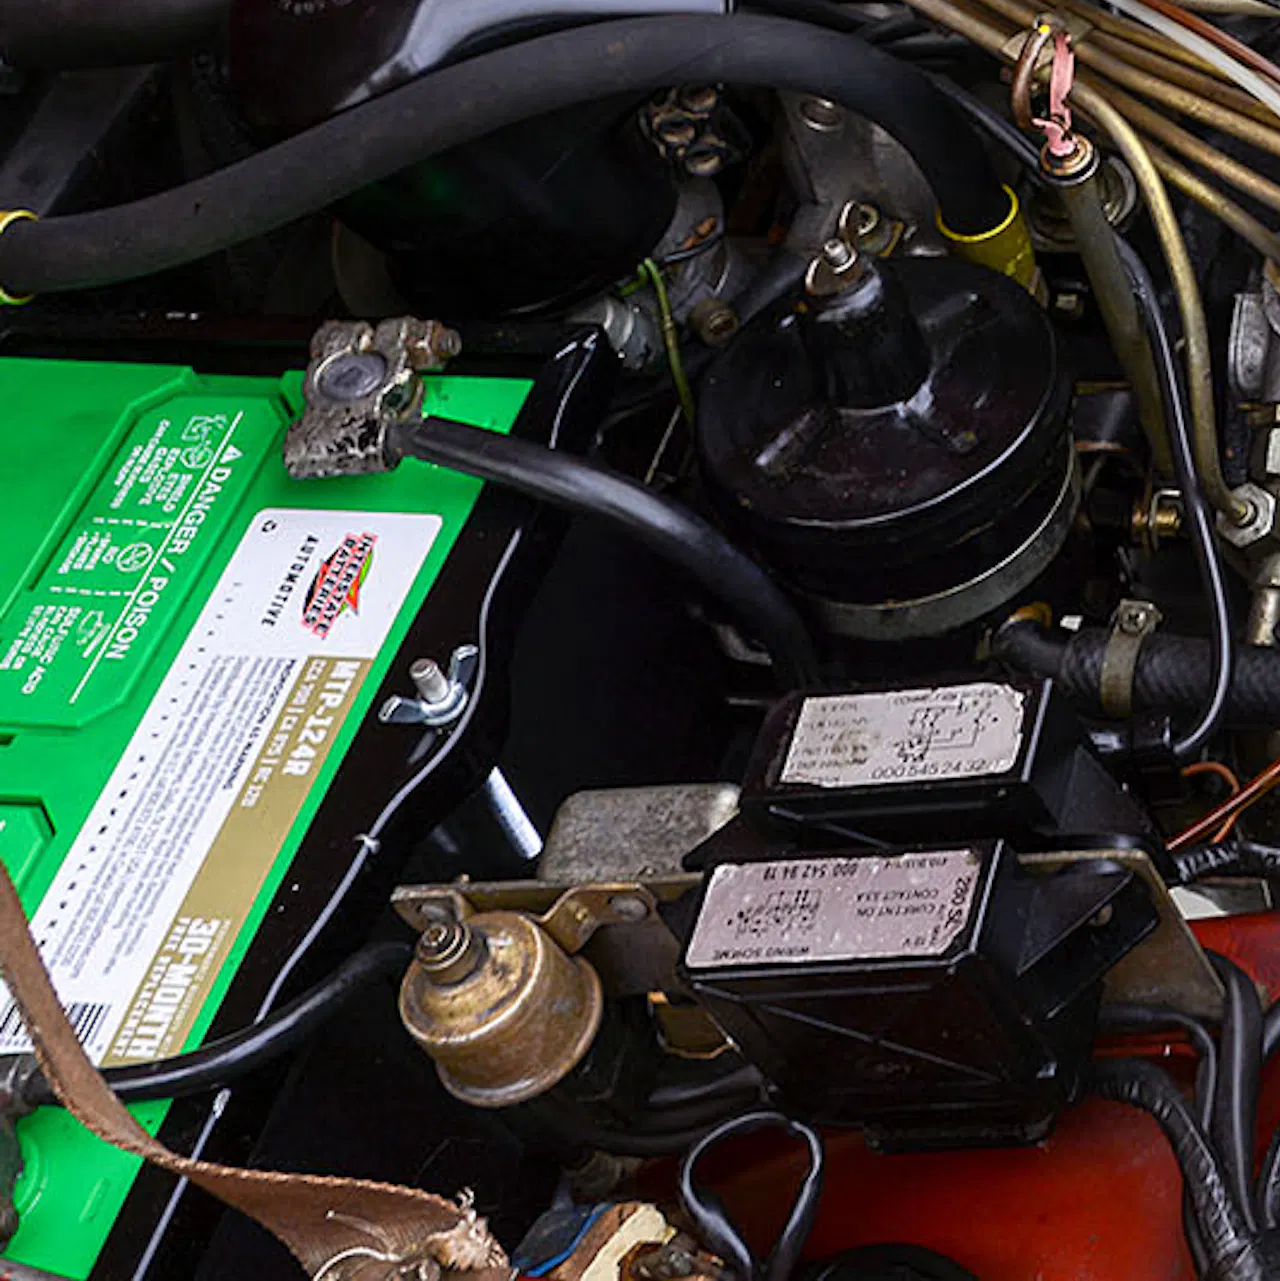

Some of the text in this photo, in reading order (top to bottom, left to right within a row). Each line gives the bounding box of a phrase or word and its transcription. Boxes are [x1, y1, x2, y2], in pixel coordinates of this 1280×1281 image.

[167, 468, 231, 555] DANGER
[106, 576, 169, 659] POISON
[262, 534, 319, 627] AUTOMOTIVE
[304, 537, 357, 626] BATTERIES
[315, 536, 373, 634] INTERSTATE
[281, 661, 361, 777] MTP-124R
[125, 919, 222, 1058] 30-MONTH
